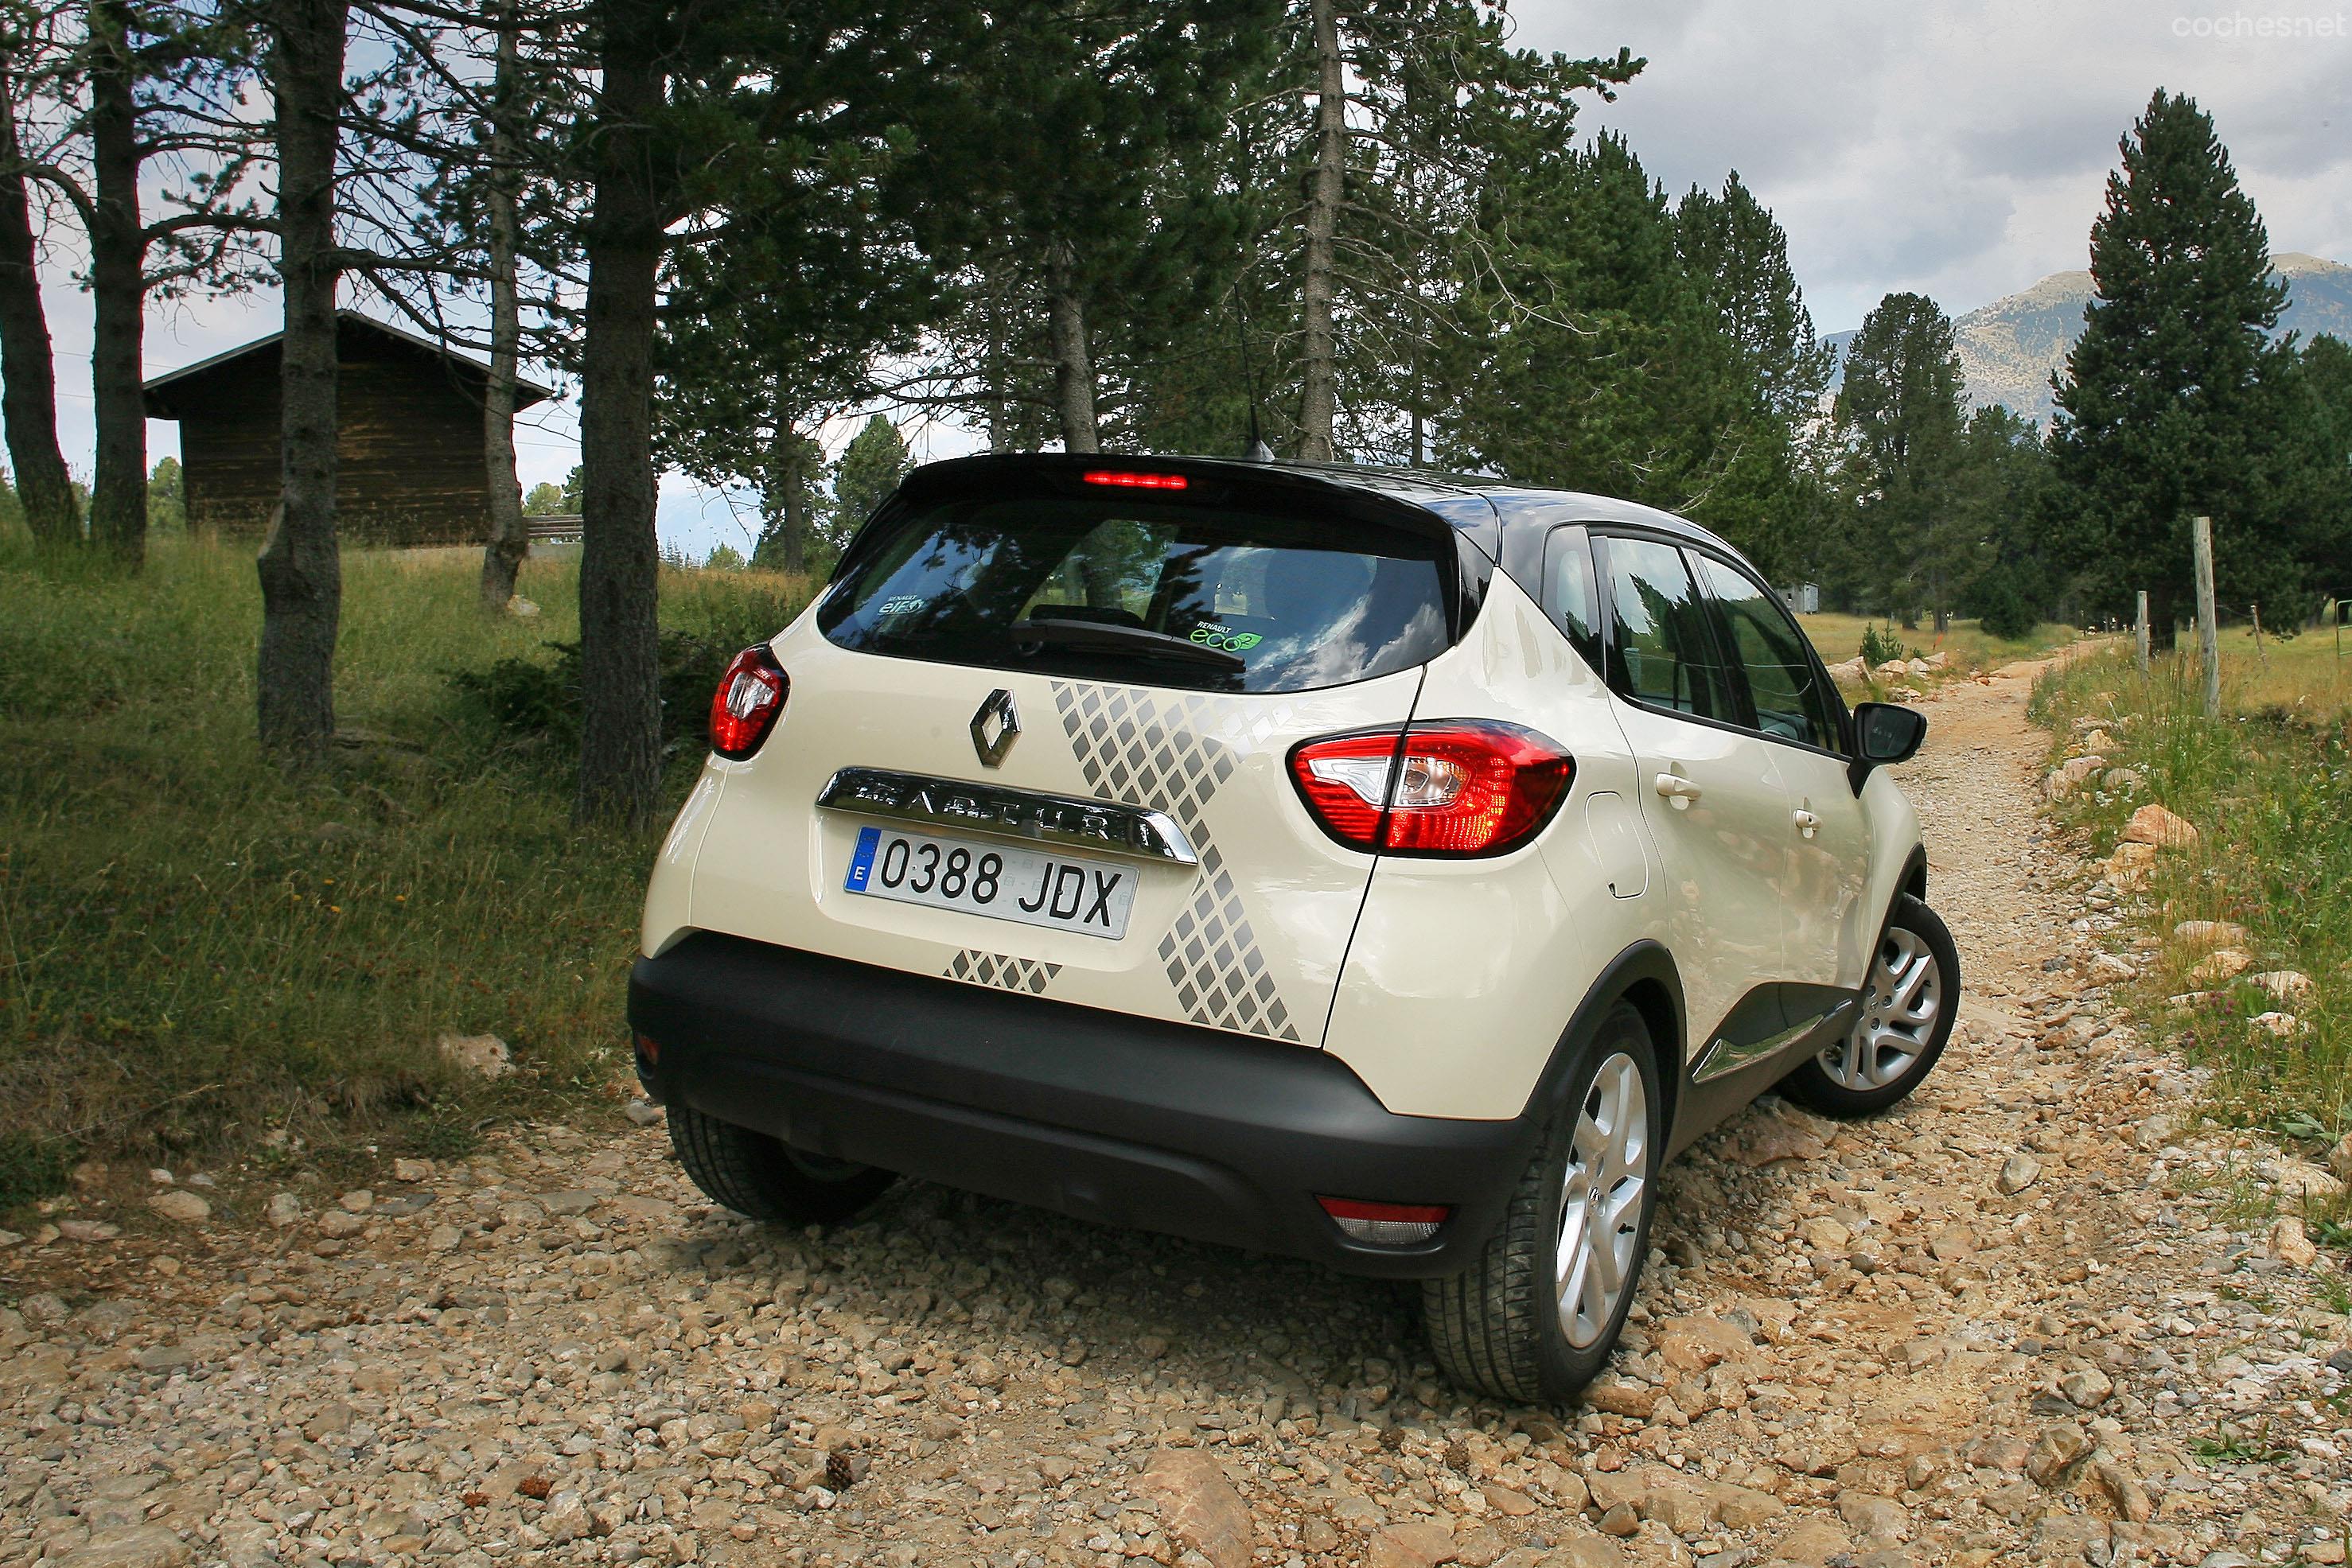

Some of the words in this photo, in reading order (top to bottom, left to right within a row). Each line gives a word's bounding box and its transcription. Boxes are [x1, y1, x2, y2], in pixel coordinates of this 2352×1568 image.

[1197, 621, 1232, 633] RENAULT
[854, 866, 866, 881] E
[880, 838, 1003, 904] 0388
[1018, 862, 1122, 927] JDX
